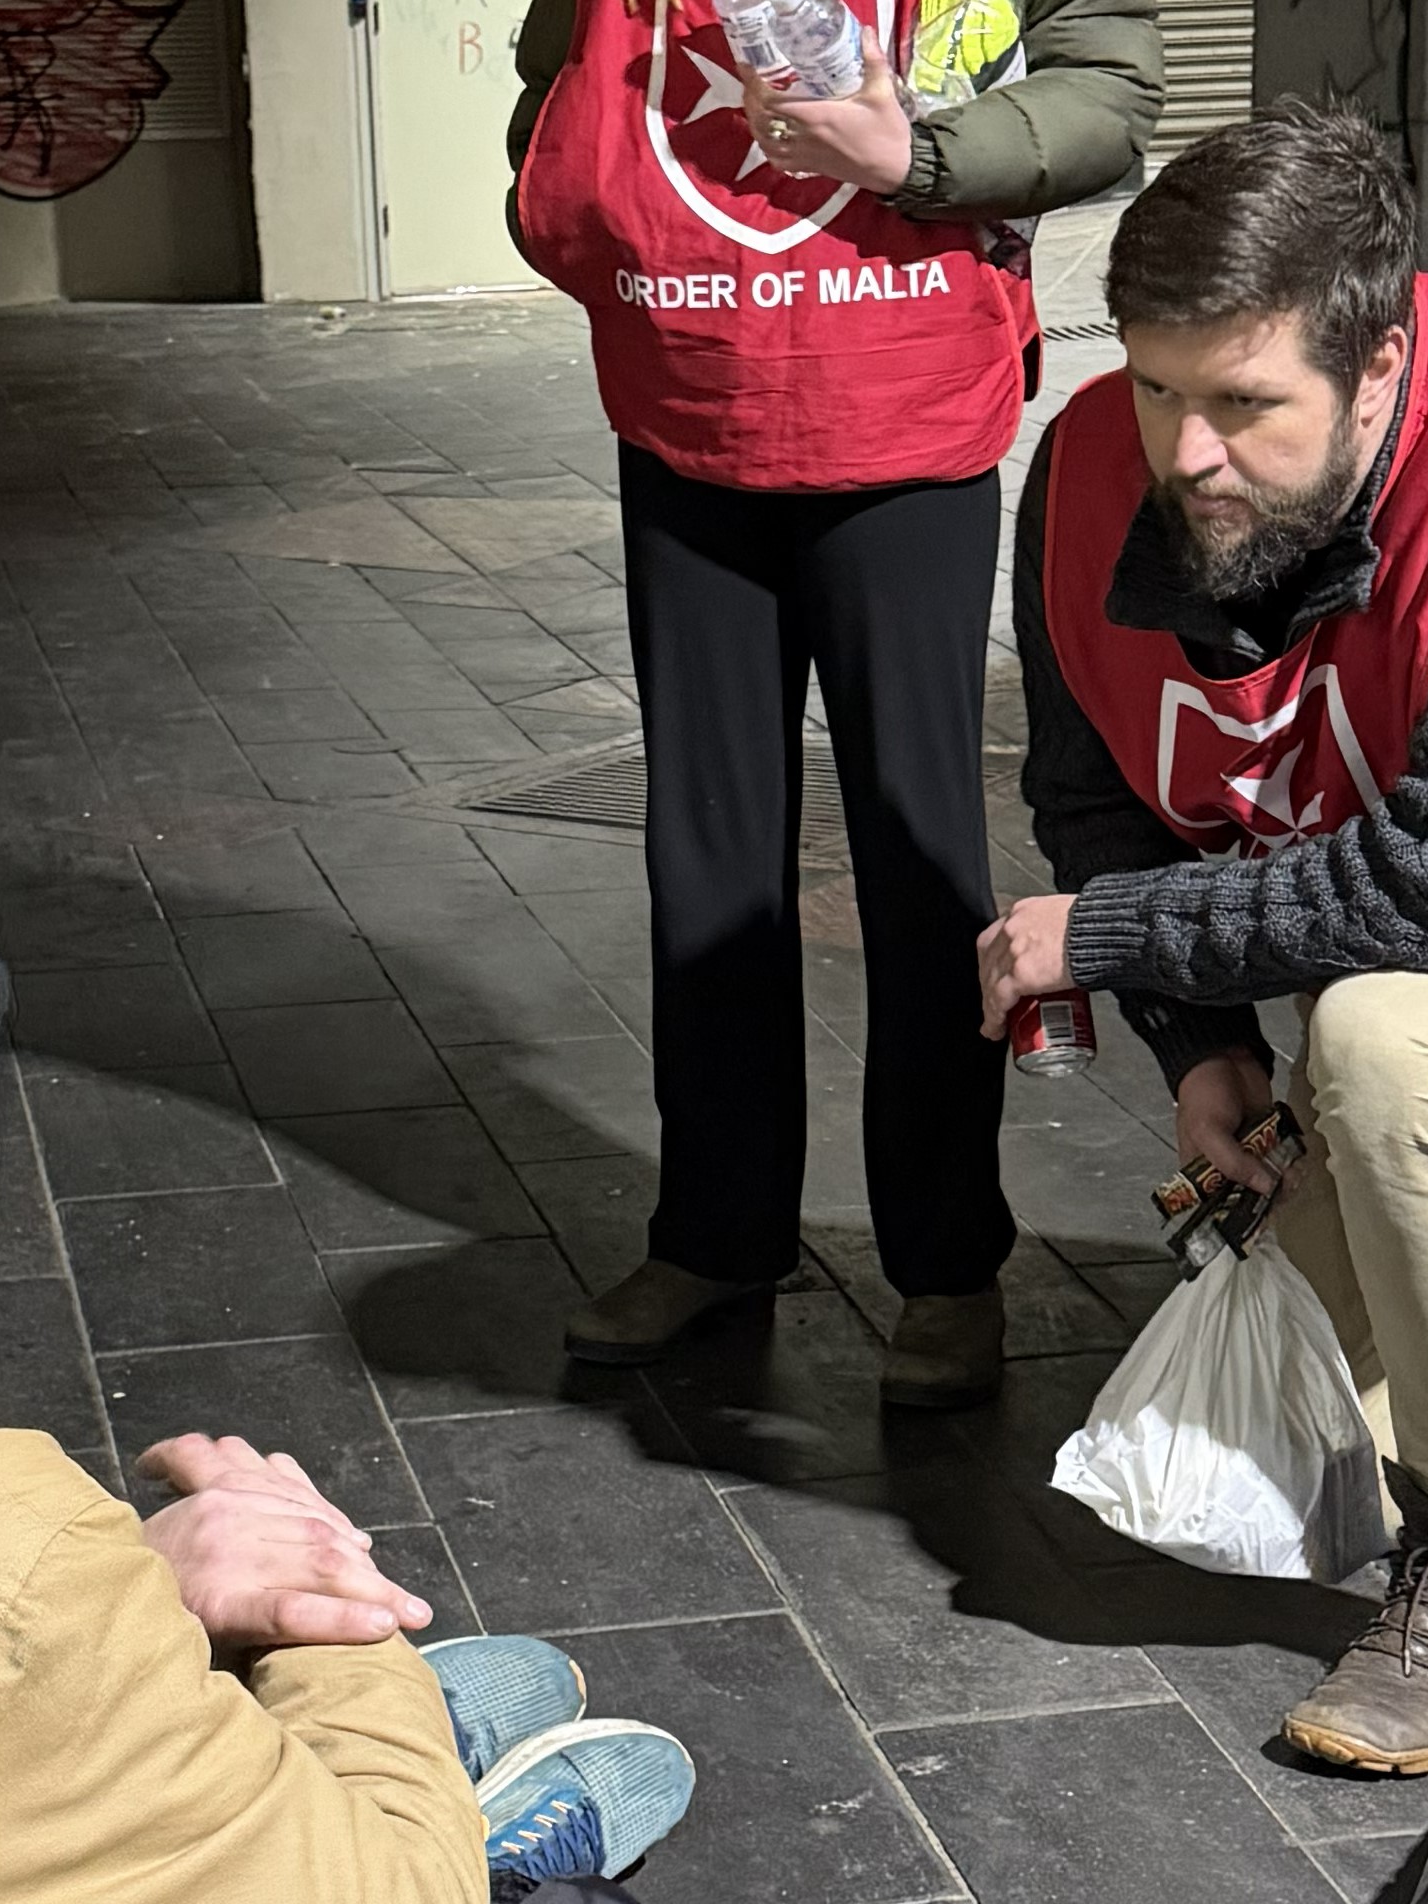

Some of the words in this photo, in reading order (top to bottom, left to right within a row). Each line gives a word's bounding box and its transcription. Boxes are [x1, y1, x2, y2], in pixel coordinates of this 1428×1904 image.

[616, 268, 737, 309] ORDER
[751, 271, 805, 308] OF
[819, 261, 950, 304] MALTA
